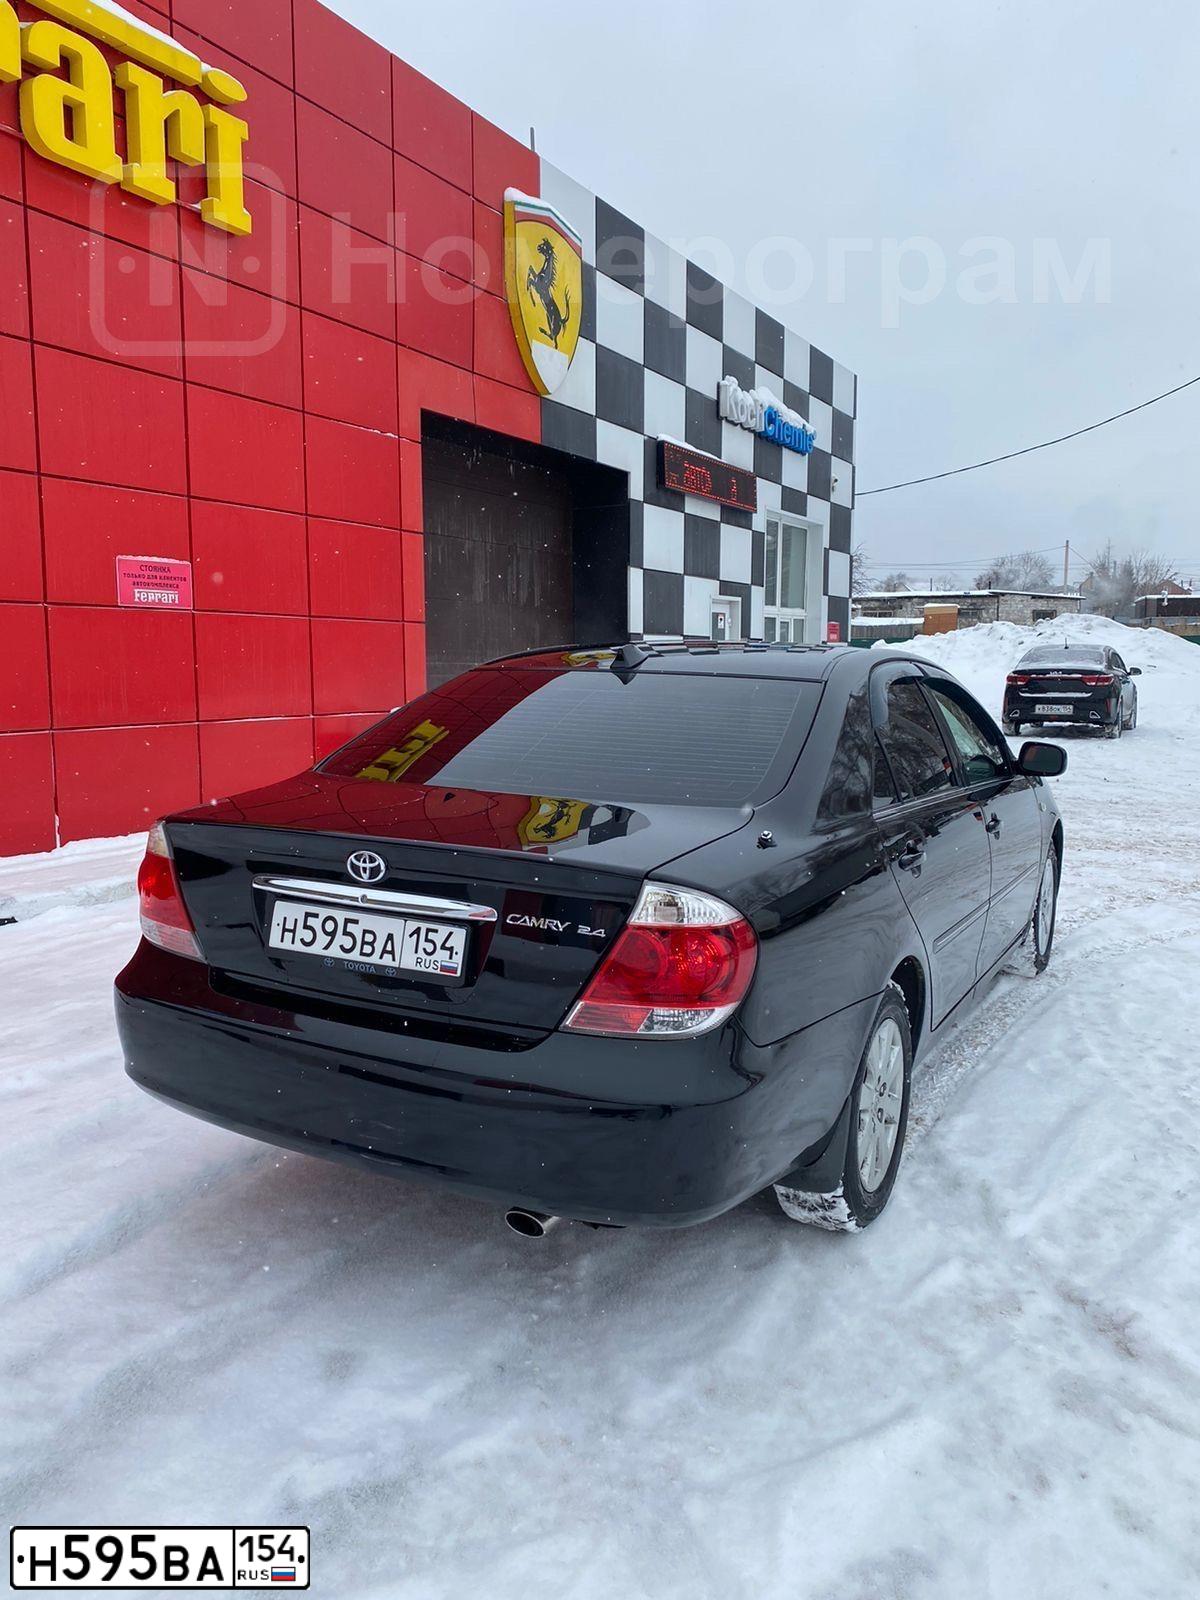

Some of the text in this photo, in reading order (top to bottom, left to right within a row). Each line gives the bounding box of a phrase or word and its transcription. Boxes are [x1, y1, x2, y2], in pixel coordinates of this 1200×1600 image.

[0, 0, 252, 235] ari
[140, 564, 171, 573] СТОЯНКА
[158, 574, 187, 582] КЛИЕНТОВ
[133, 588, 179, 604] Ferrari
[506, 913, 571, 932] CAMRY
[408, 926, 455, 961] 154
[343, 960, 377, 974] TOYOTA
[415, 955, 440, 971] RUS
